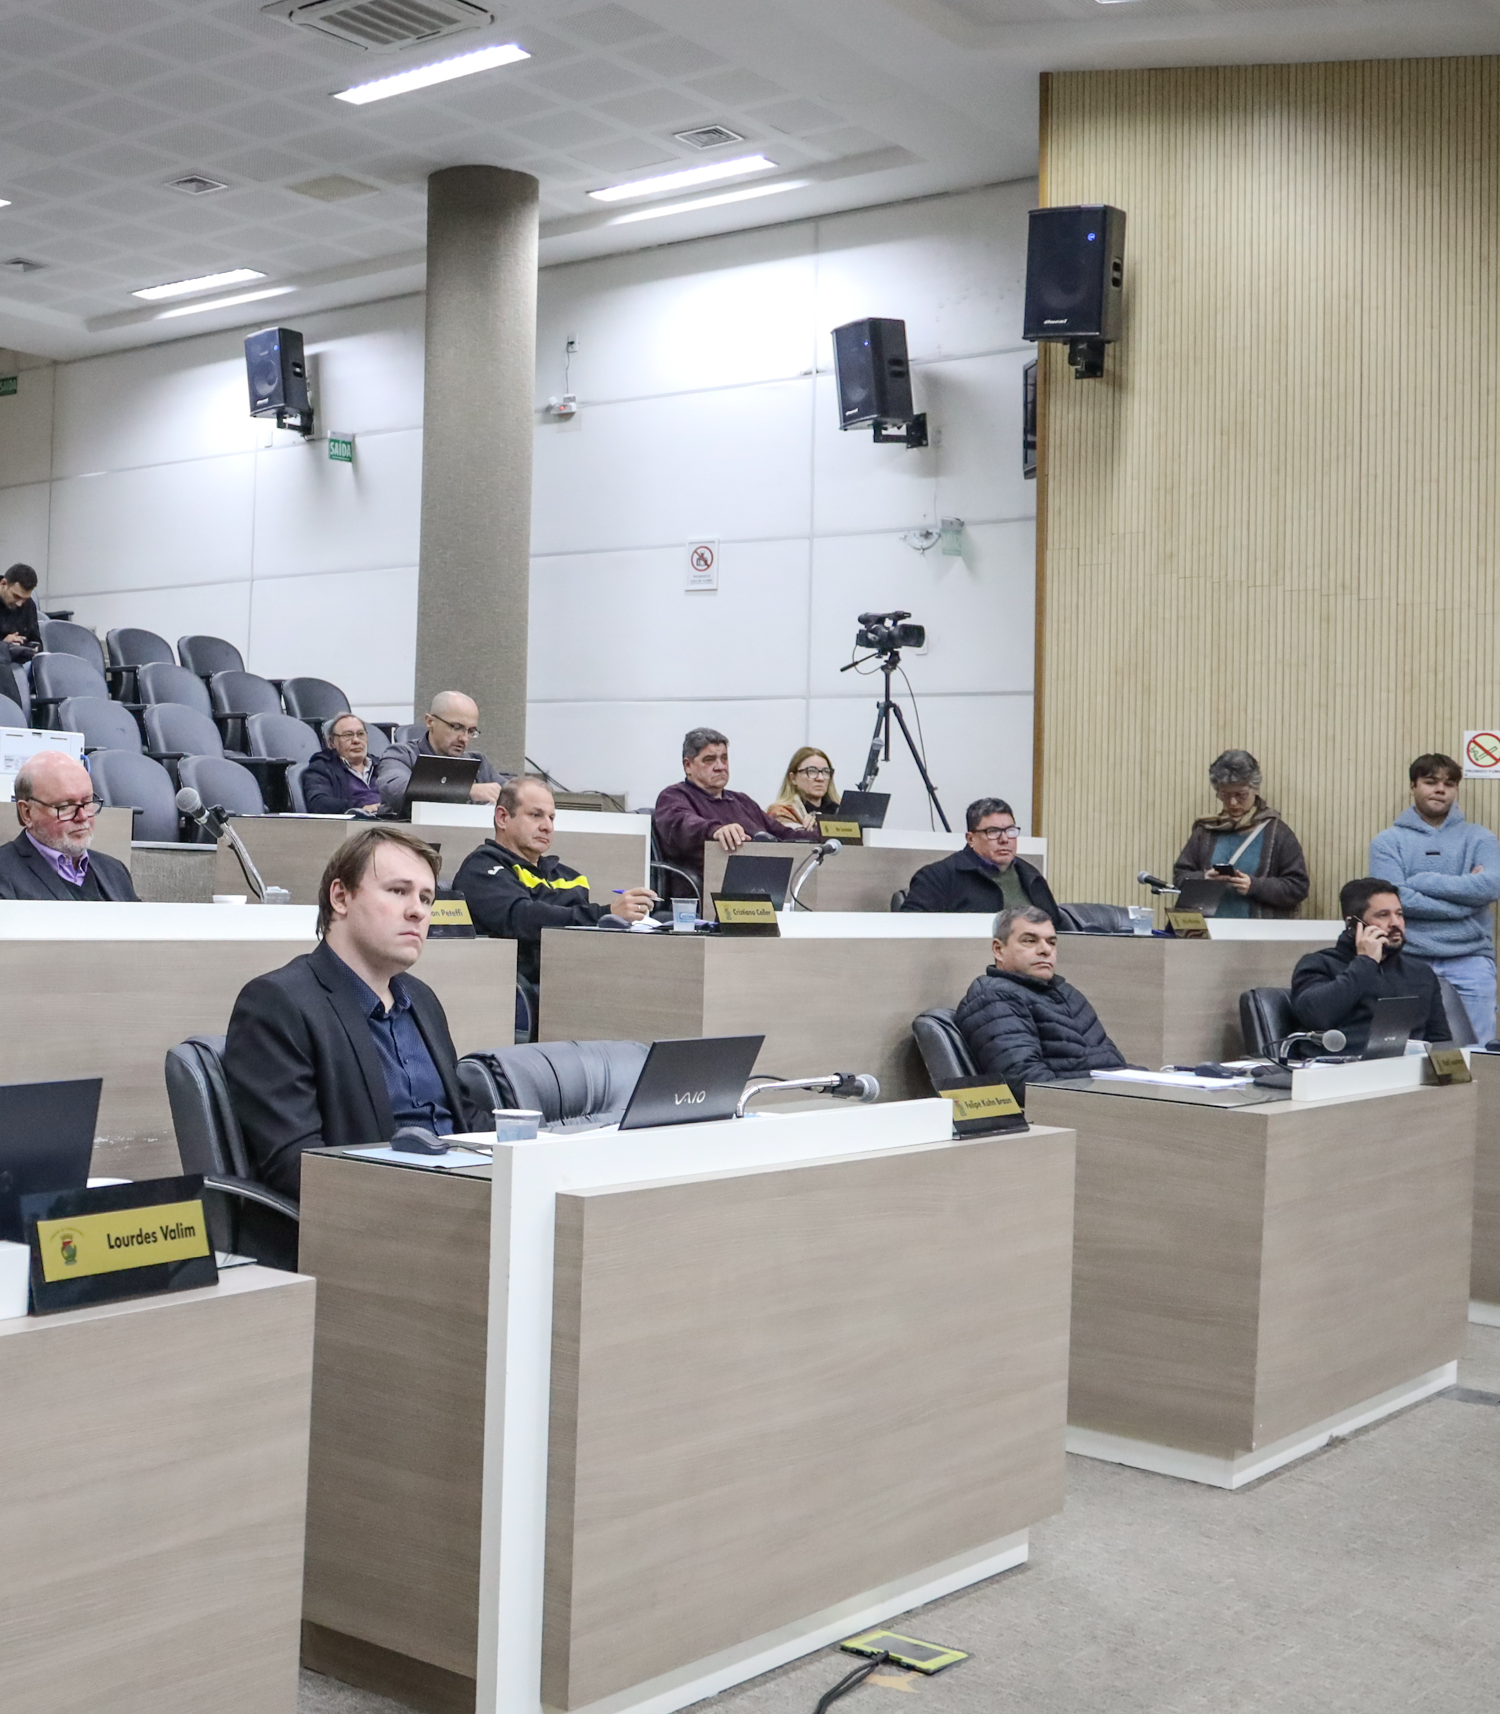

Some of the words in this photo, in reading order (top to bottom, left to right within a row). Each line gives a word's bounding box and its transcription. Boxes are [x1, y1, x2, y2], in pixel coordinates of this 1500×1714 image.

[329, 441, 352, 458] SAÍDA
[441, 908, 463, 917] Peteffi
[675, 1090, 706, 1105] VAIO
[965, 1100, 982, 1110] Felipe
[107, 1228, 158, 1249] Lourdes
[160, 1223, 196, 1241] Valim
